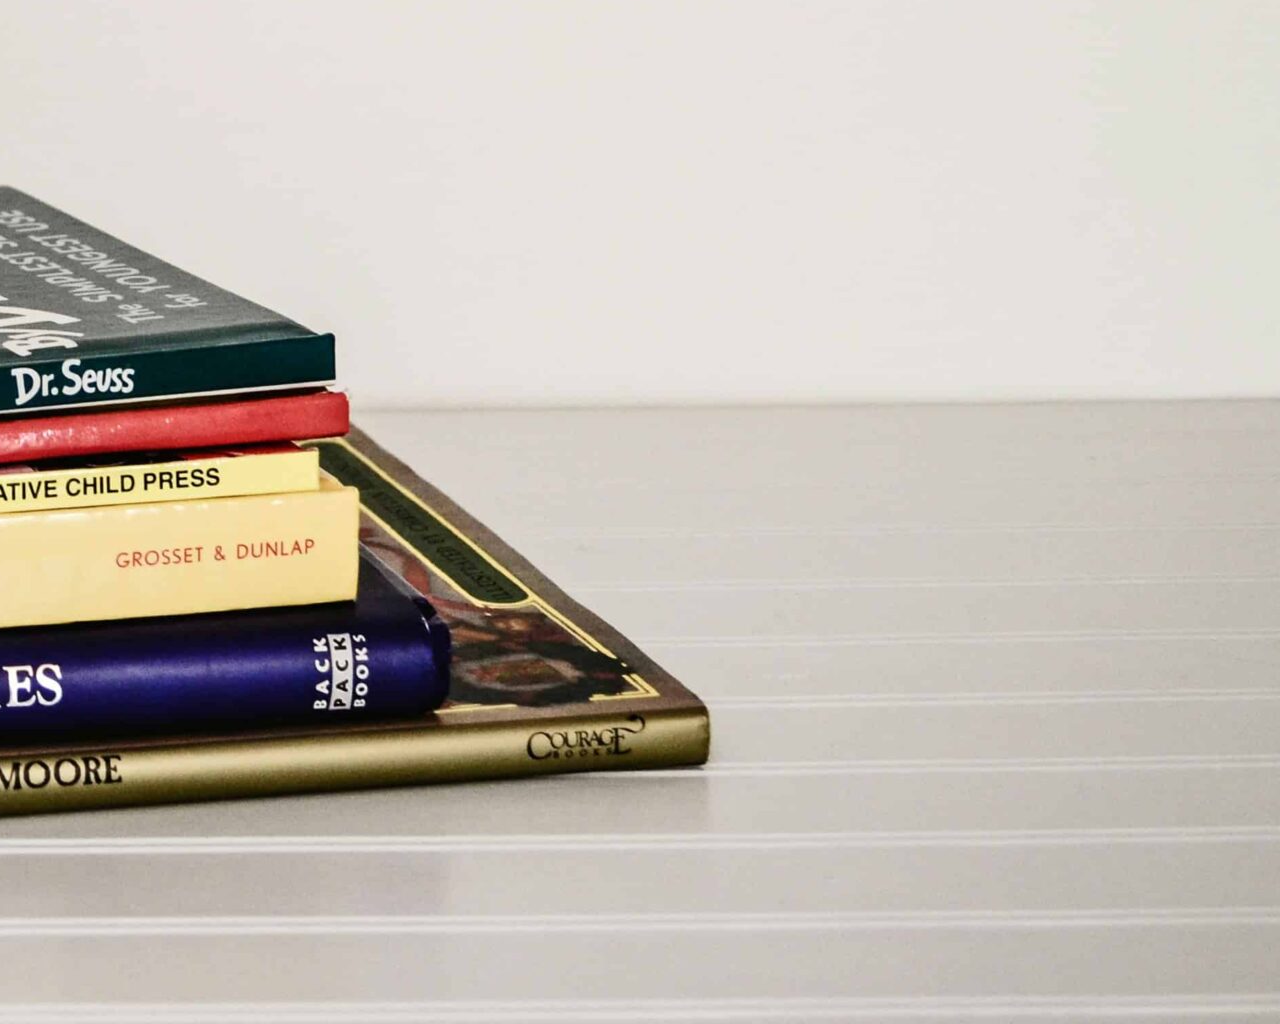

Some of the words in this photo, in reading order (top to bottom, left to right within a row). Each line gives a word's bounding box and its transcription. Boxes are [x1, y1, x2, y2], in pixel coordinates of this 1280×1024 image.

[29, 234, 170, 293] YOUNGEST
[116, 302, 164, 324] The
[164, 293, 207, 309] for
[65, 473, 136, 497] CHILD
[144, 467, 221, 491] PRESS
[115, 546, 204, 569] GROSSET
[213, 545, 226, 561] &
[236, 538, 315, 559] DUNLAP
[312, 637, 330, 710] BACK
[333, 637, 349, 708] PACK
[352, 634, 370, 708] BOOKS
[526, 713, 646, 760] COURAGE
